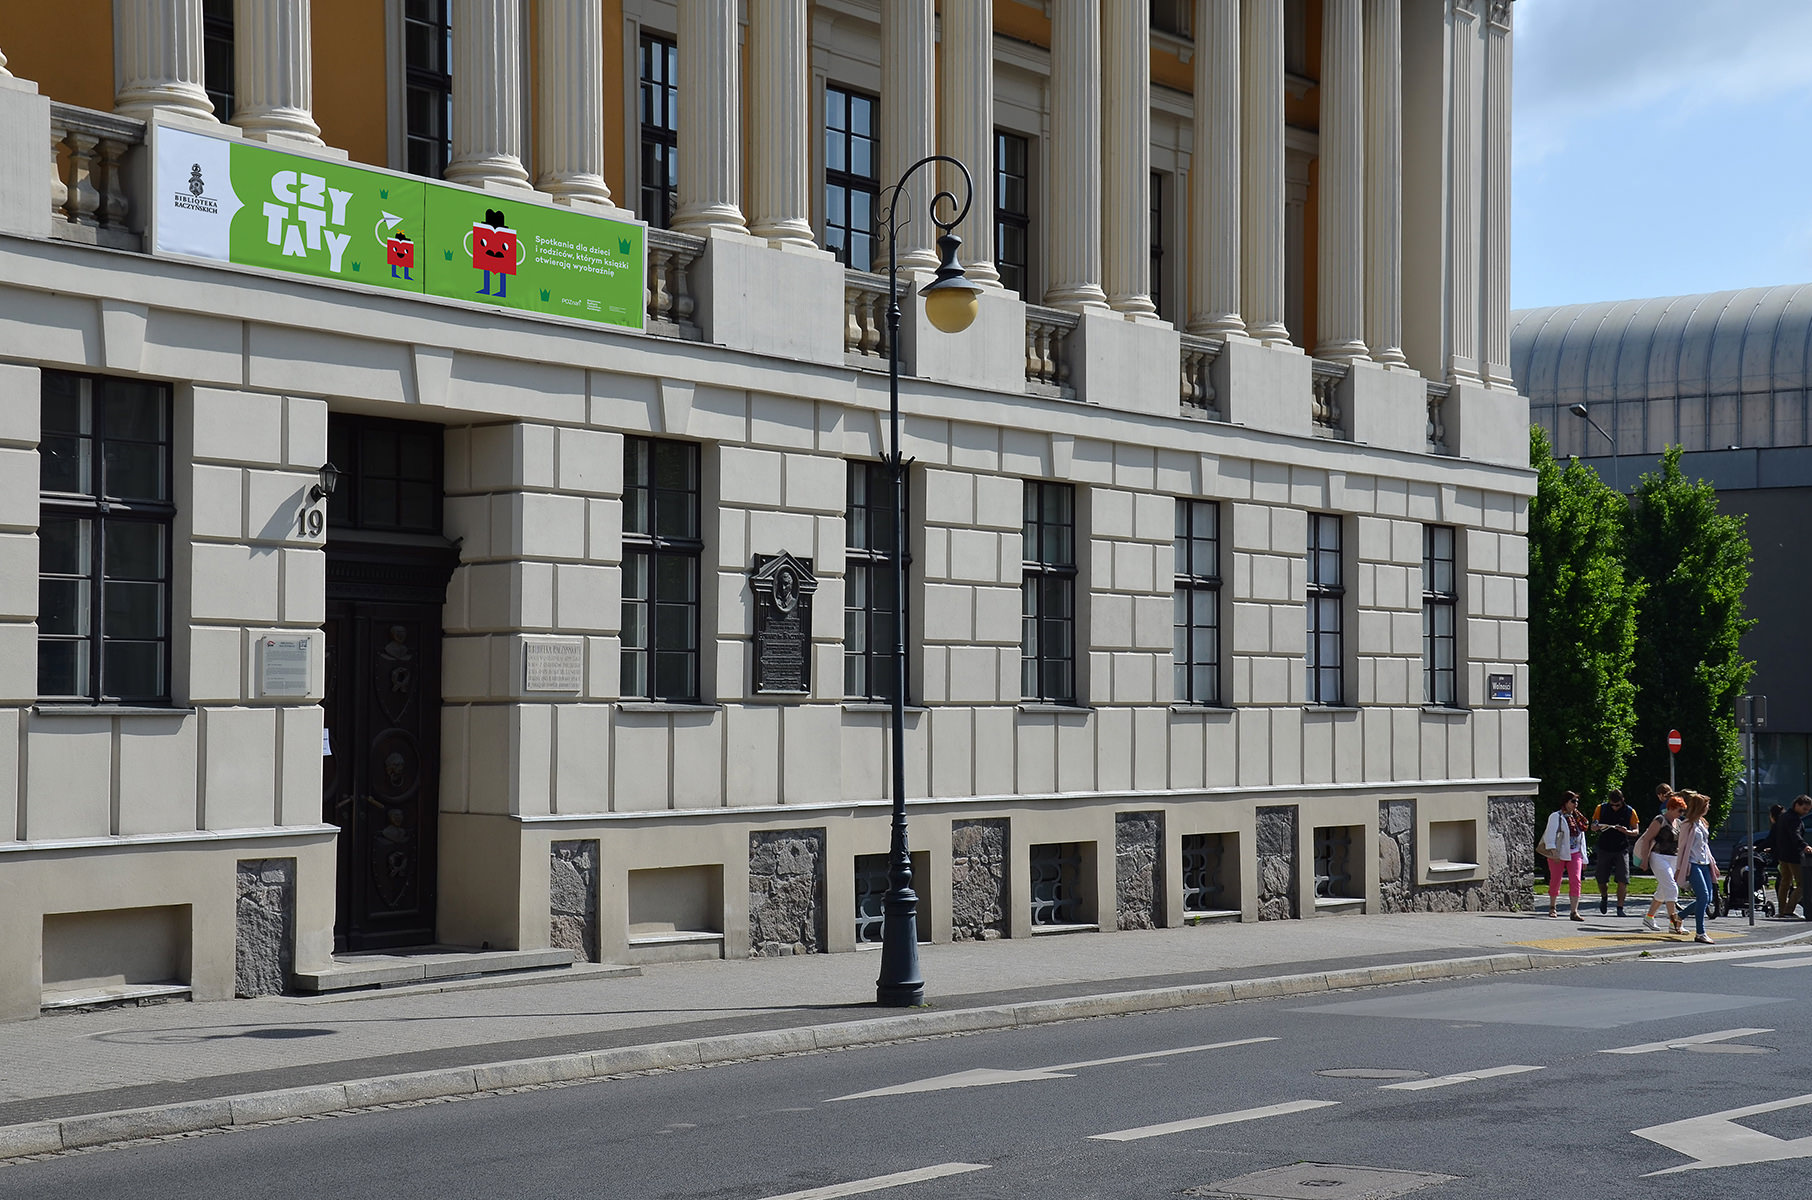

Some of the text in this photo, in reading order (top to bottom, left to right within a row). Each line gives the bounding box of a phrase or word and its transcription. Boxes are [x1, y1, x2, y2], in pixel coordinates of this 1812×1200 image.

[175, 195, 217, 207] BIBLIOTEKA
[175, 202, 217, 214] RACZYŃSKICH
[271, 170, 353, 226] CZY
[263, 202, 352, 273] TATY
[536, 236, 611, 256] Spotkania dla dzieci
[536, 257, 614, 277] otwierają wyobraźnię
[540, 247, 574, 259] rodziców,
[576, 254, 602, 265] którym
[605, 259, 629, 269] książki
[297, 508, 324, 537] 19
